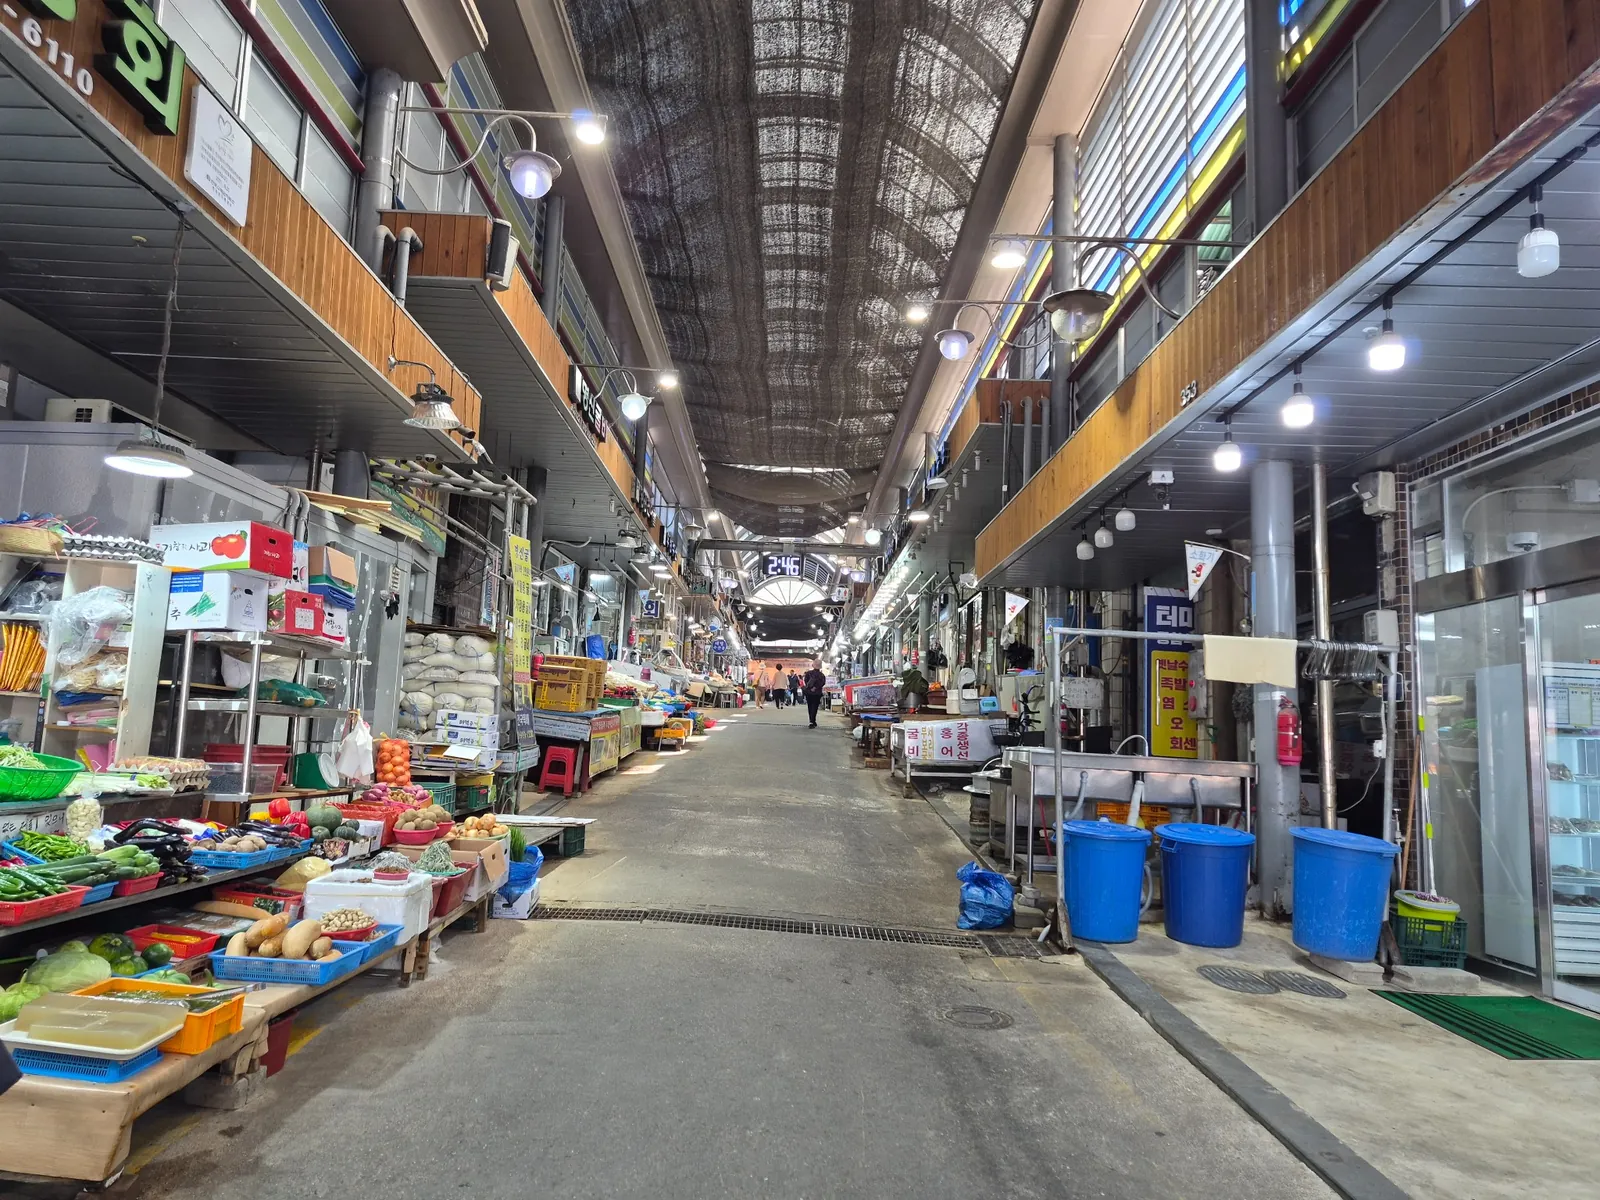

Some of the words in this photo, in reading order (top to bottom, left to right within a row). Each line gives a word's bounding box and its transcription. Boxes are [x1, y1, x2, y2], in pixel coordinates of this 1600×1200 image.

[768, 556, 800, 576] 2:46
[643, 599, 660, 618] 회
[907, 728, 919, 757] 굴비
[941, 727, 953, 758] 홍어
[957, 722, 969, 760] 각종생선
